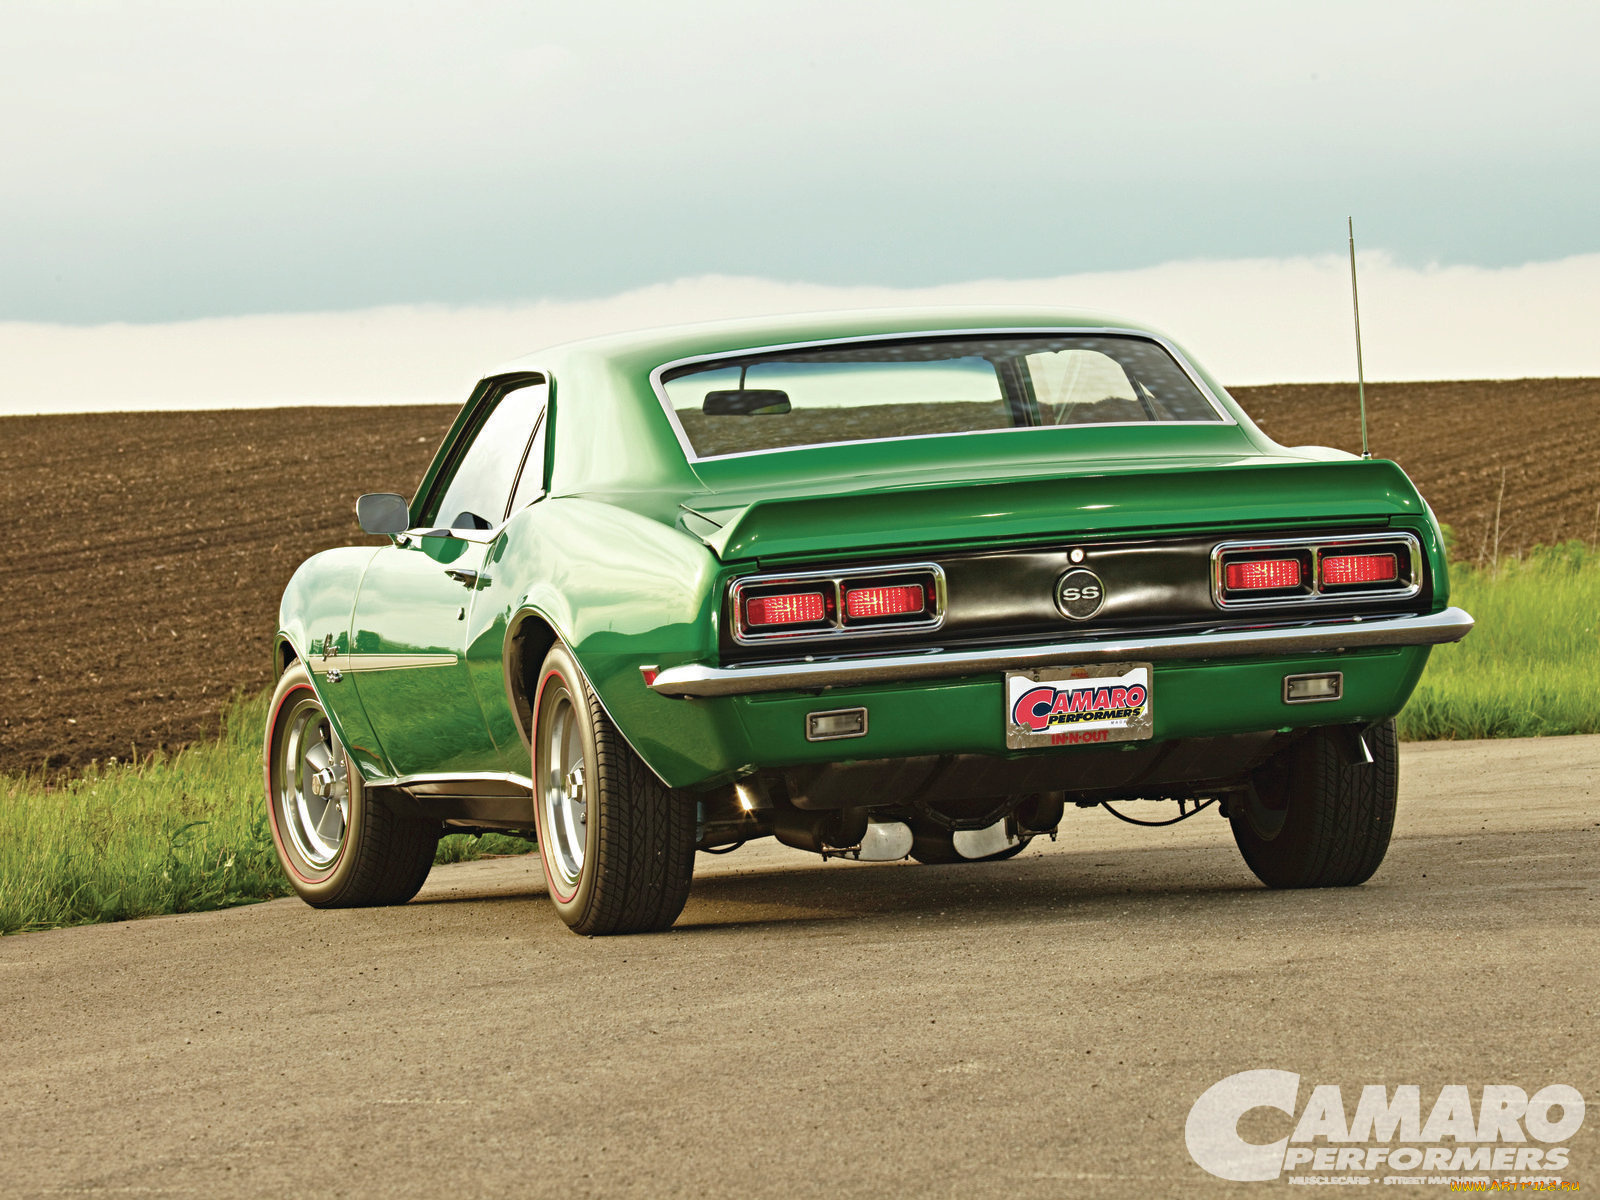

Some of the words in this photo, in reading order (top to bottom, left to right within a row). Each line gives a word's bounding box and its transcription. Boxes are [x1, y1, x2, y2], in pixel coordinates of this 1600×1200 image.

[1063, 586, 1099, 601] SS
[1014, 685, 1147, 731] CAMARO
[1049, 708, 1141, 724] PERFORMERS
